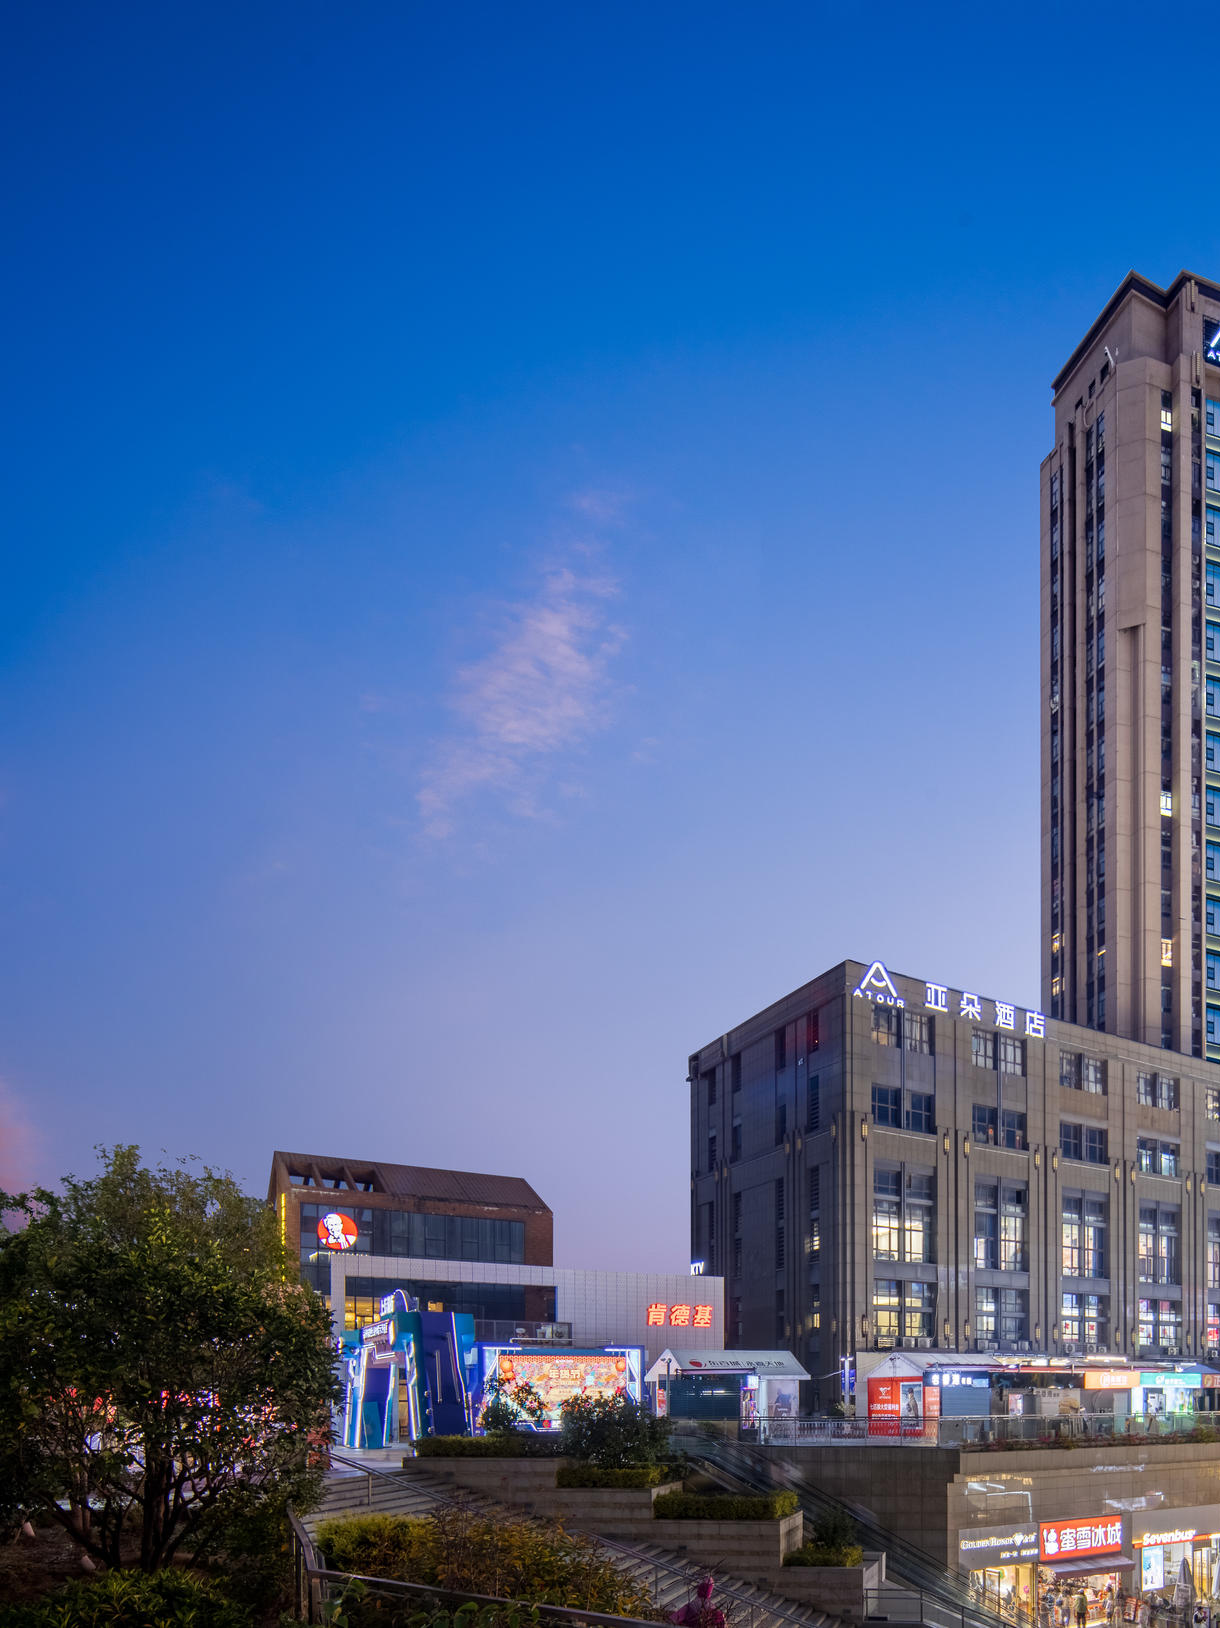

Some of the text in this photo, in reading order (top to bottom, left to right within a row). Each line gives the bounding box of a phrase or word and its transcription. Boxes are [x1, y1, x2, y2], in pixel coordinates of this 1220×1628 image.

[853, 988, 905, 1008] ATOUR
[925, 982, 1045, 1038] 亚朵酒店
[647, 1303, 713, 1328] 肯德基
[1060, 1522, 1121, 1552] 蜜雪冰城
